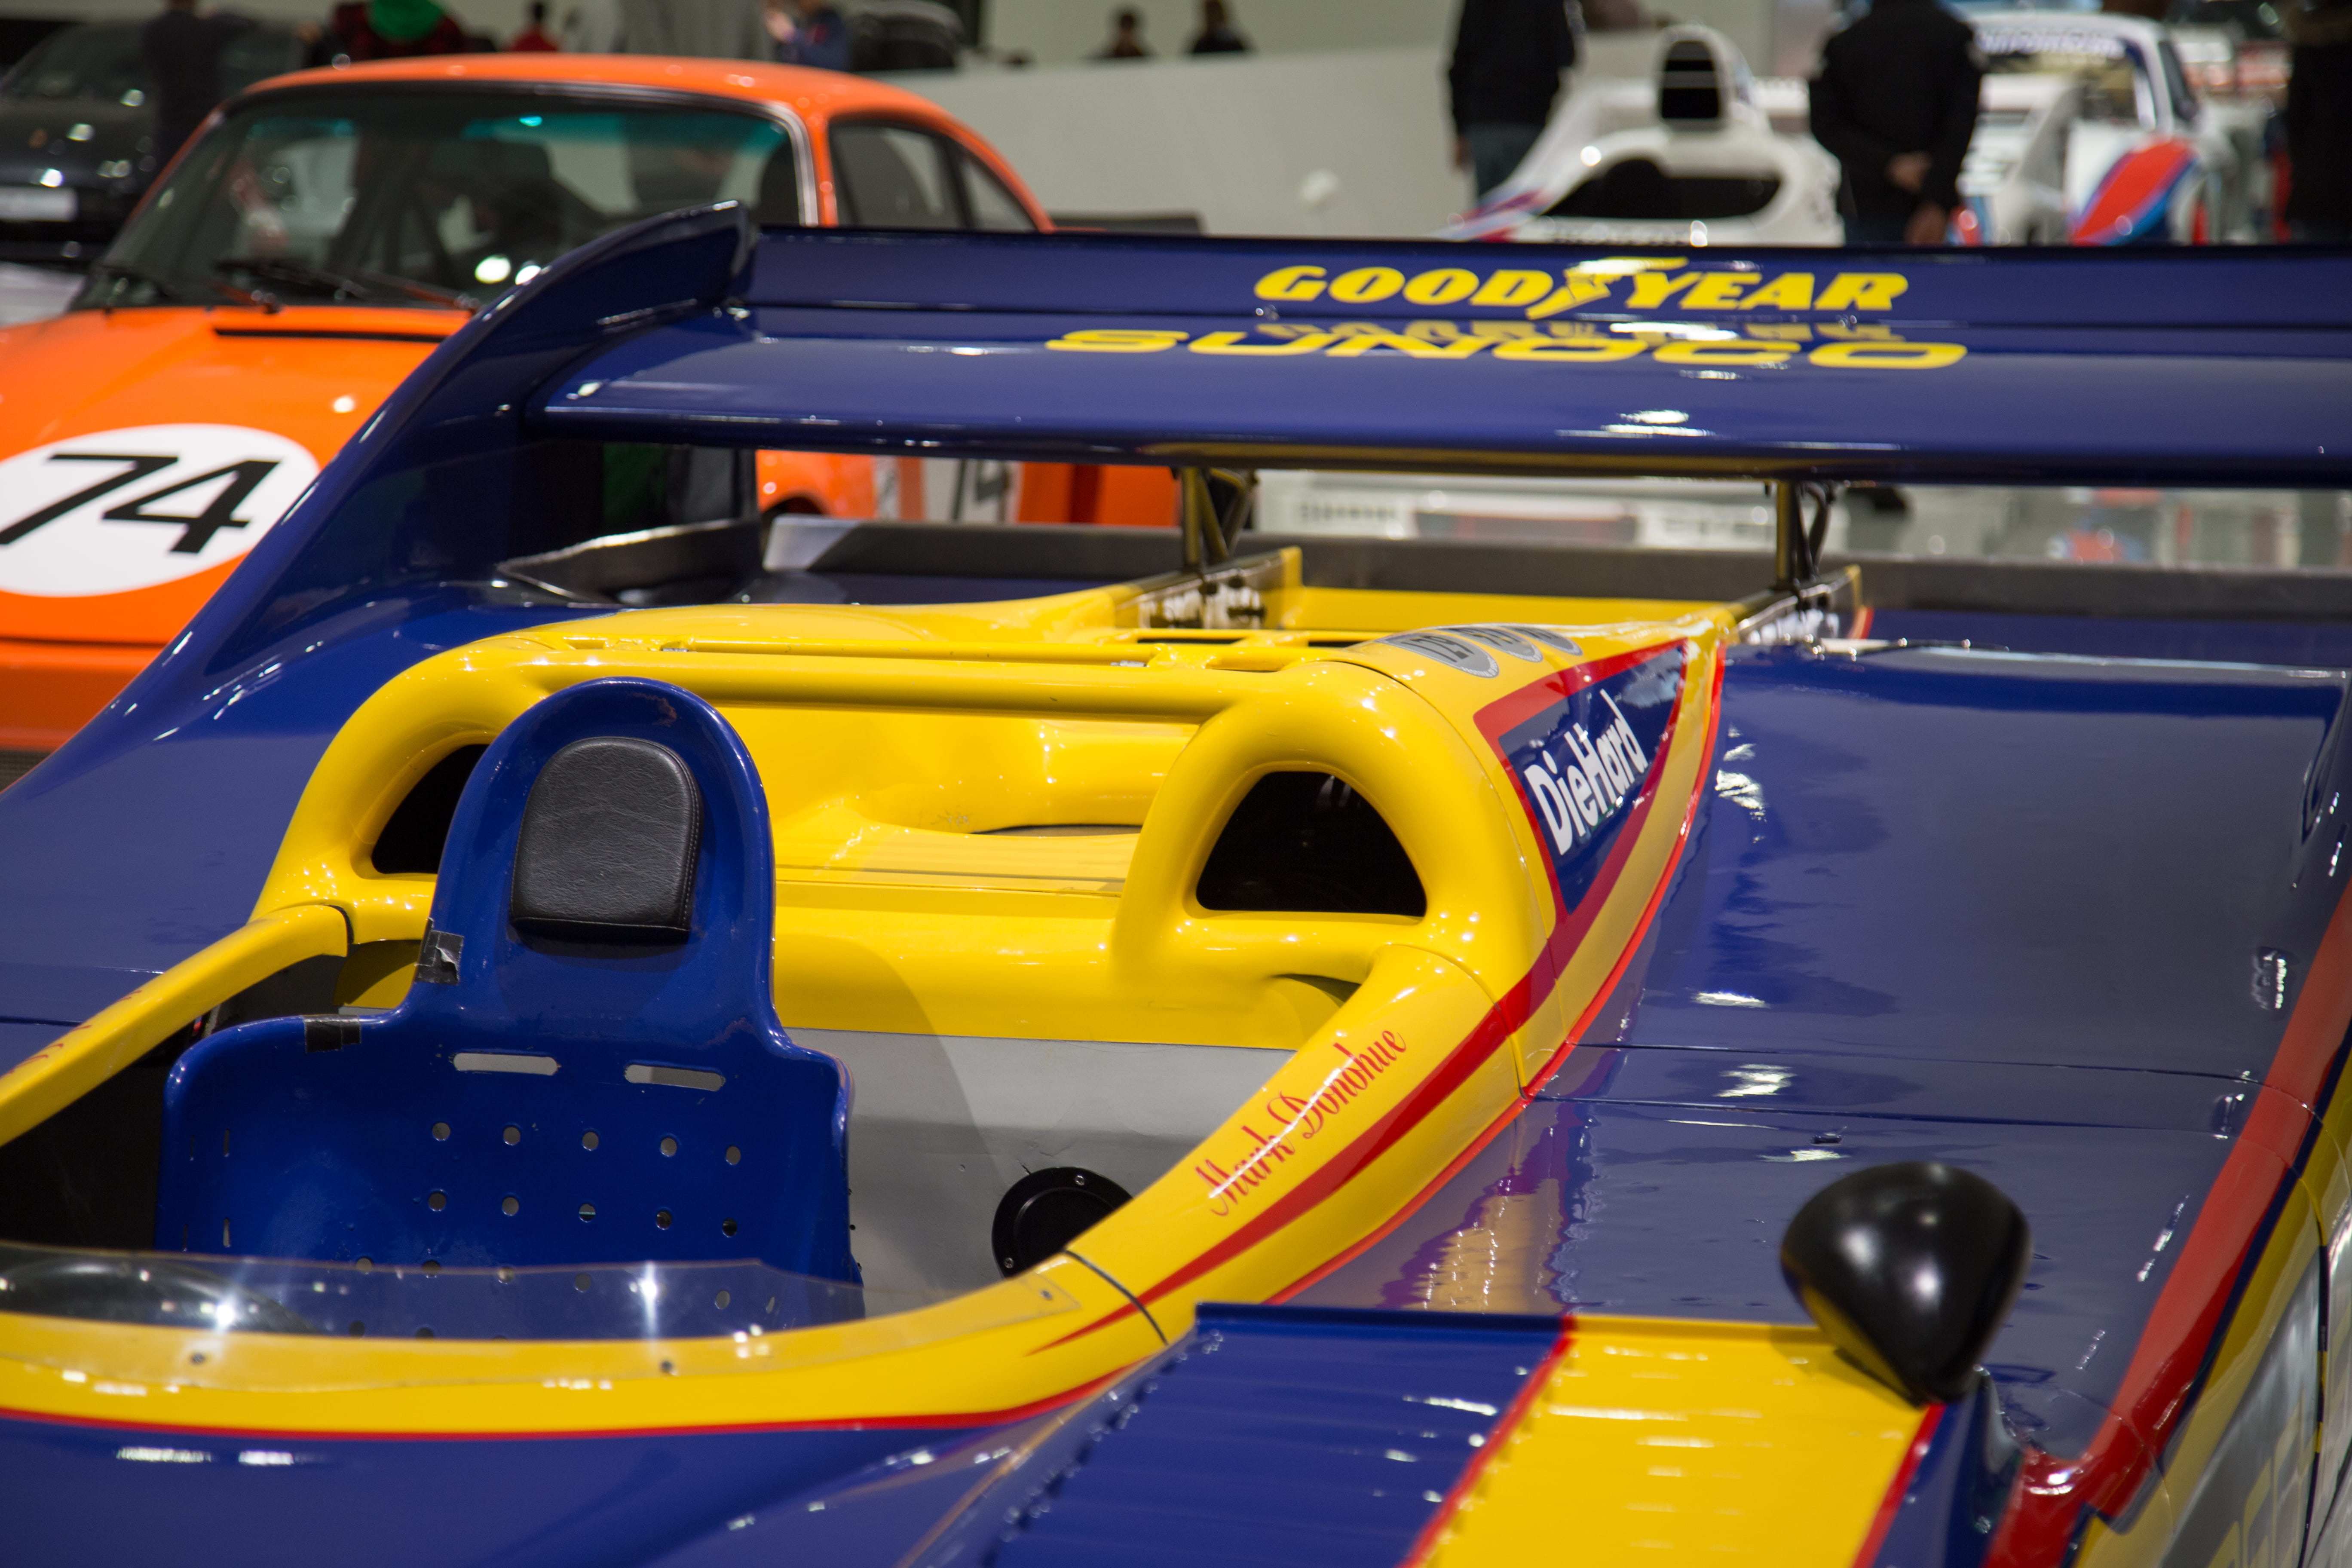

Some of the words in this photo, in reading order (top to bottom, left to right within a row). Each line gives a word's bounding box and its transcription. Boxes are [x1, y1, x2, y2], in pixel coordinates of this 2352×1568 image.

[1254, 259, 1908, 319] GOODYEAR
[1045, 329, 1967, 369] SUNOCO
[0, 453, 282, 554] 74
[1523, 689, 1648, 855] DieHard
[1195, 1125, 1295, 1216] Mark
[1266, 1030, 1407, 1139] Donohue
